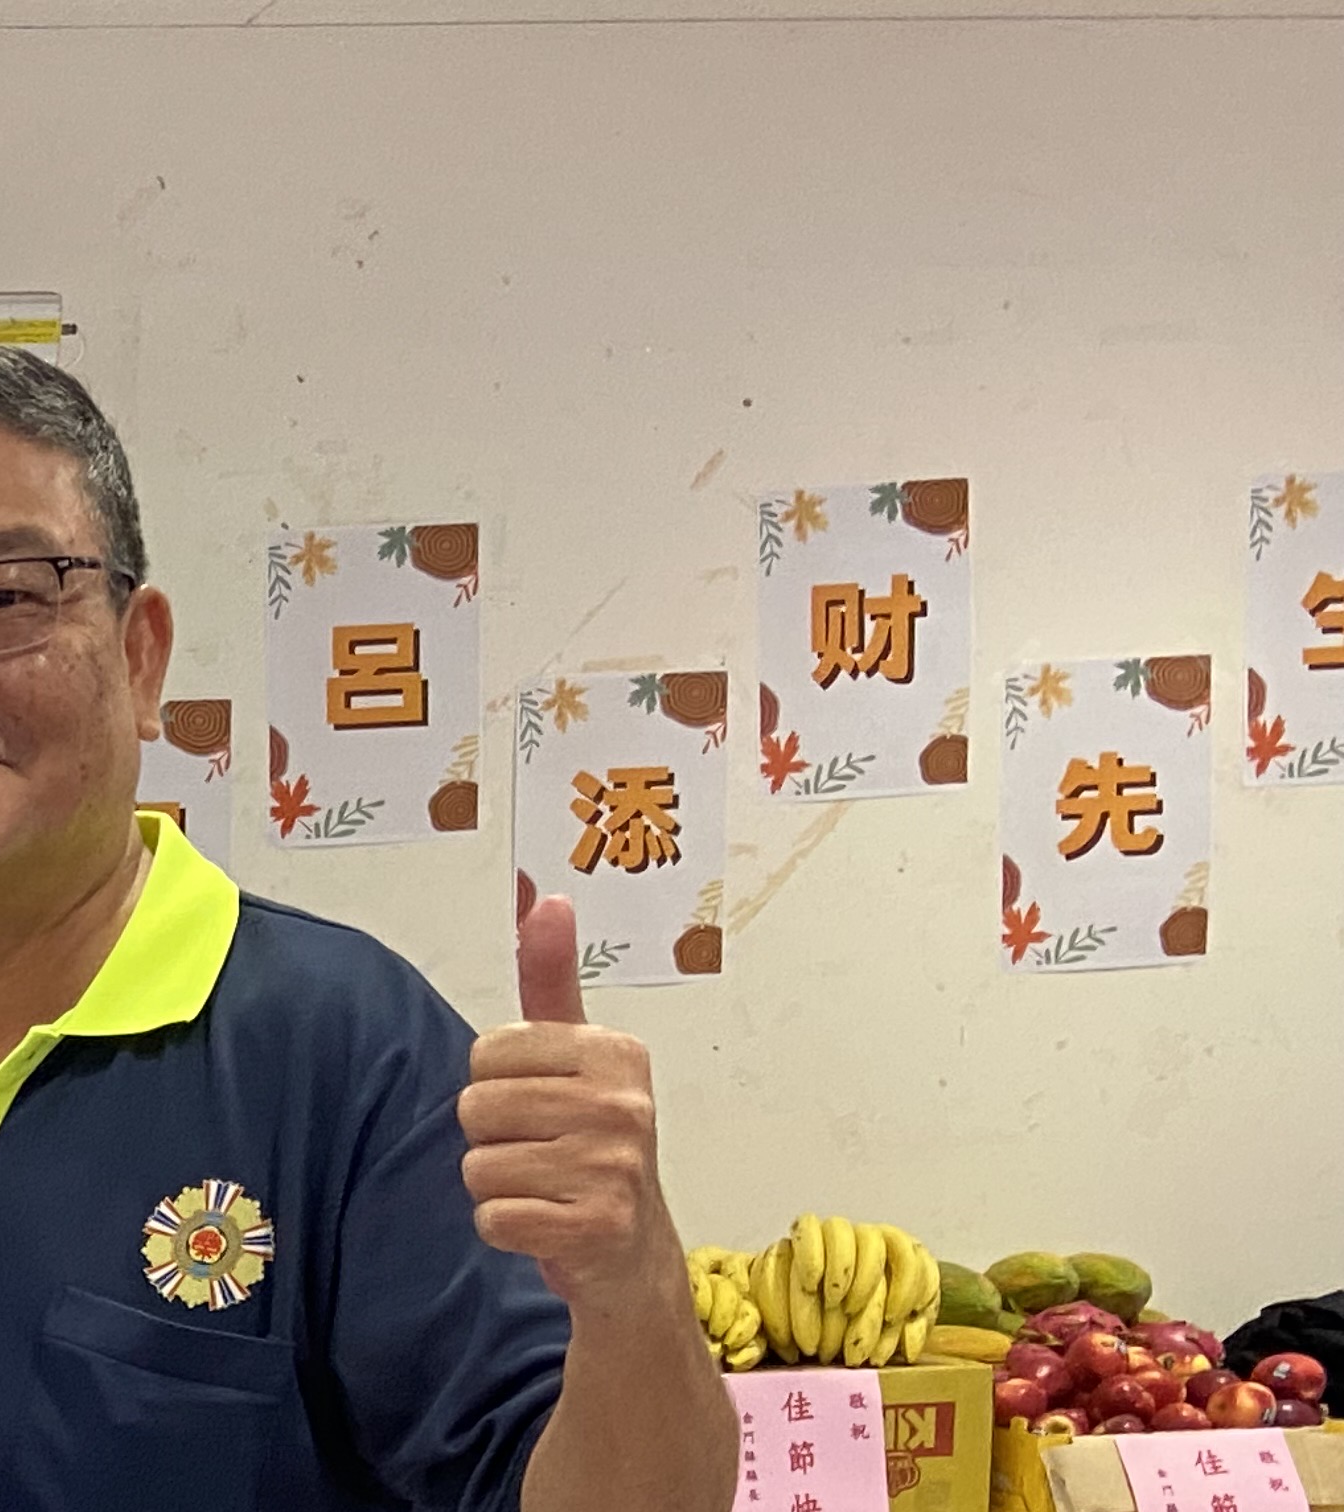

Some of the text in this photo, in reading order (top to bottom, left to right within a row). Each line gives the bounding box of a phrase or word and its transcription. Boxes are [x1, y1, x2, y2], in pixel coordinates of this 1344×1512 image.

[326, 622, 429, 731] 呂
[569, 766, 682, 874] 添
[1055, 751, 1164, 861] 先
